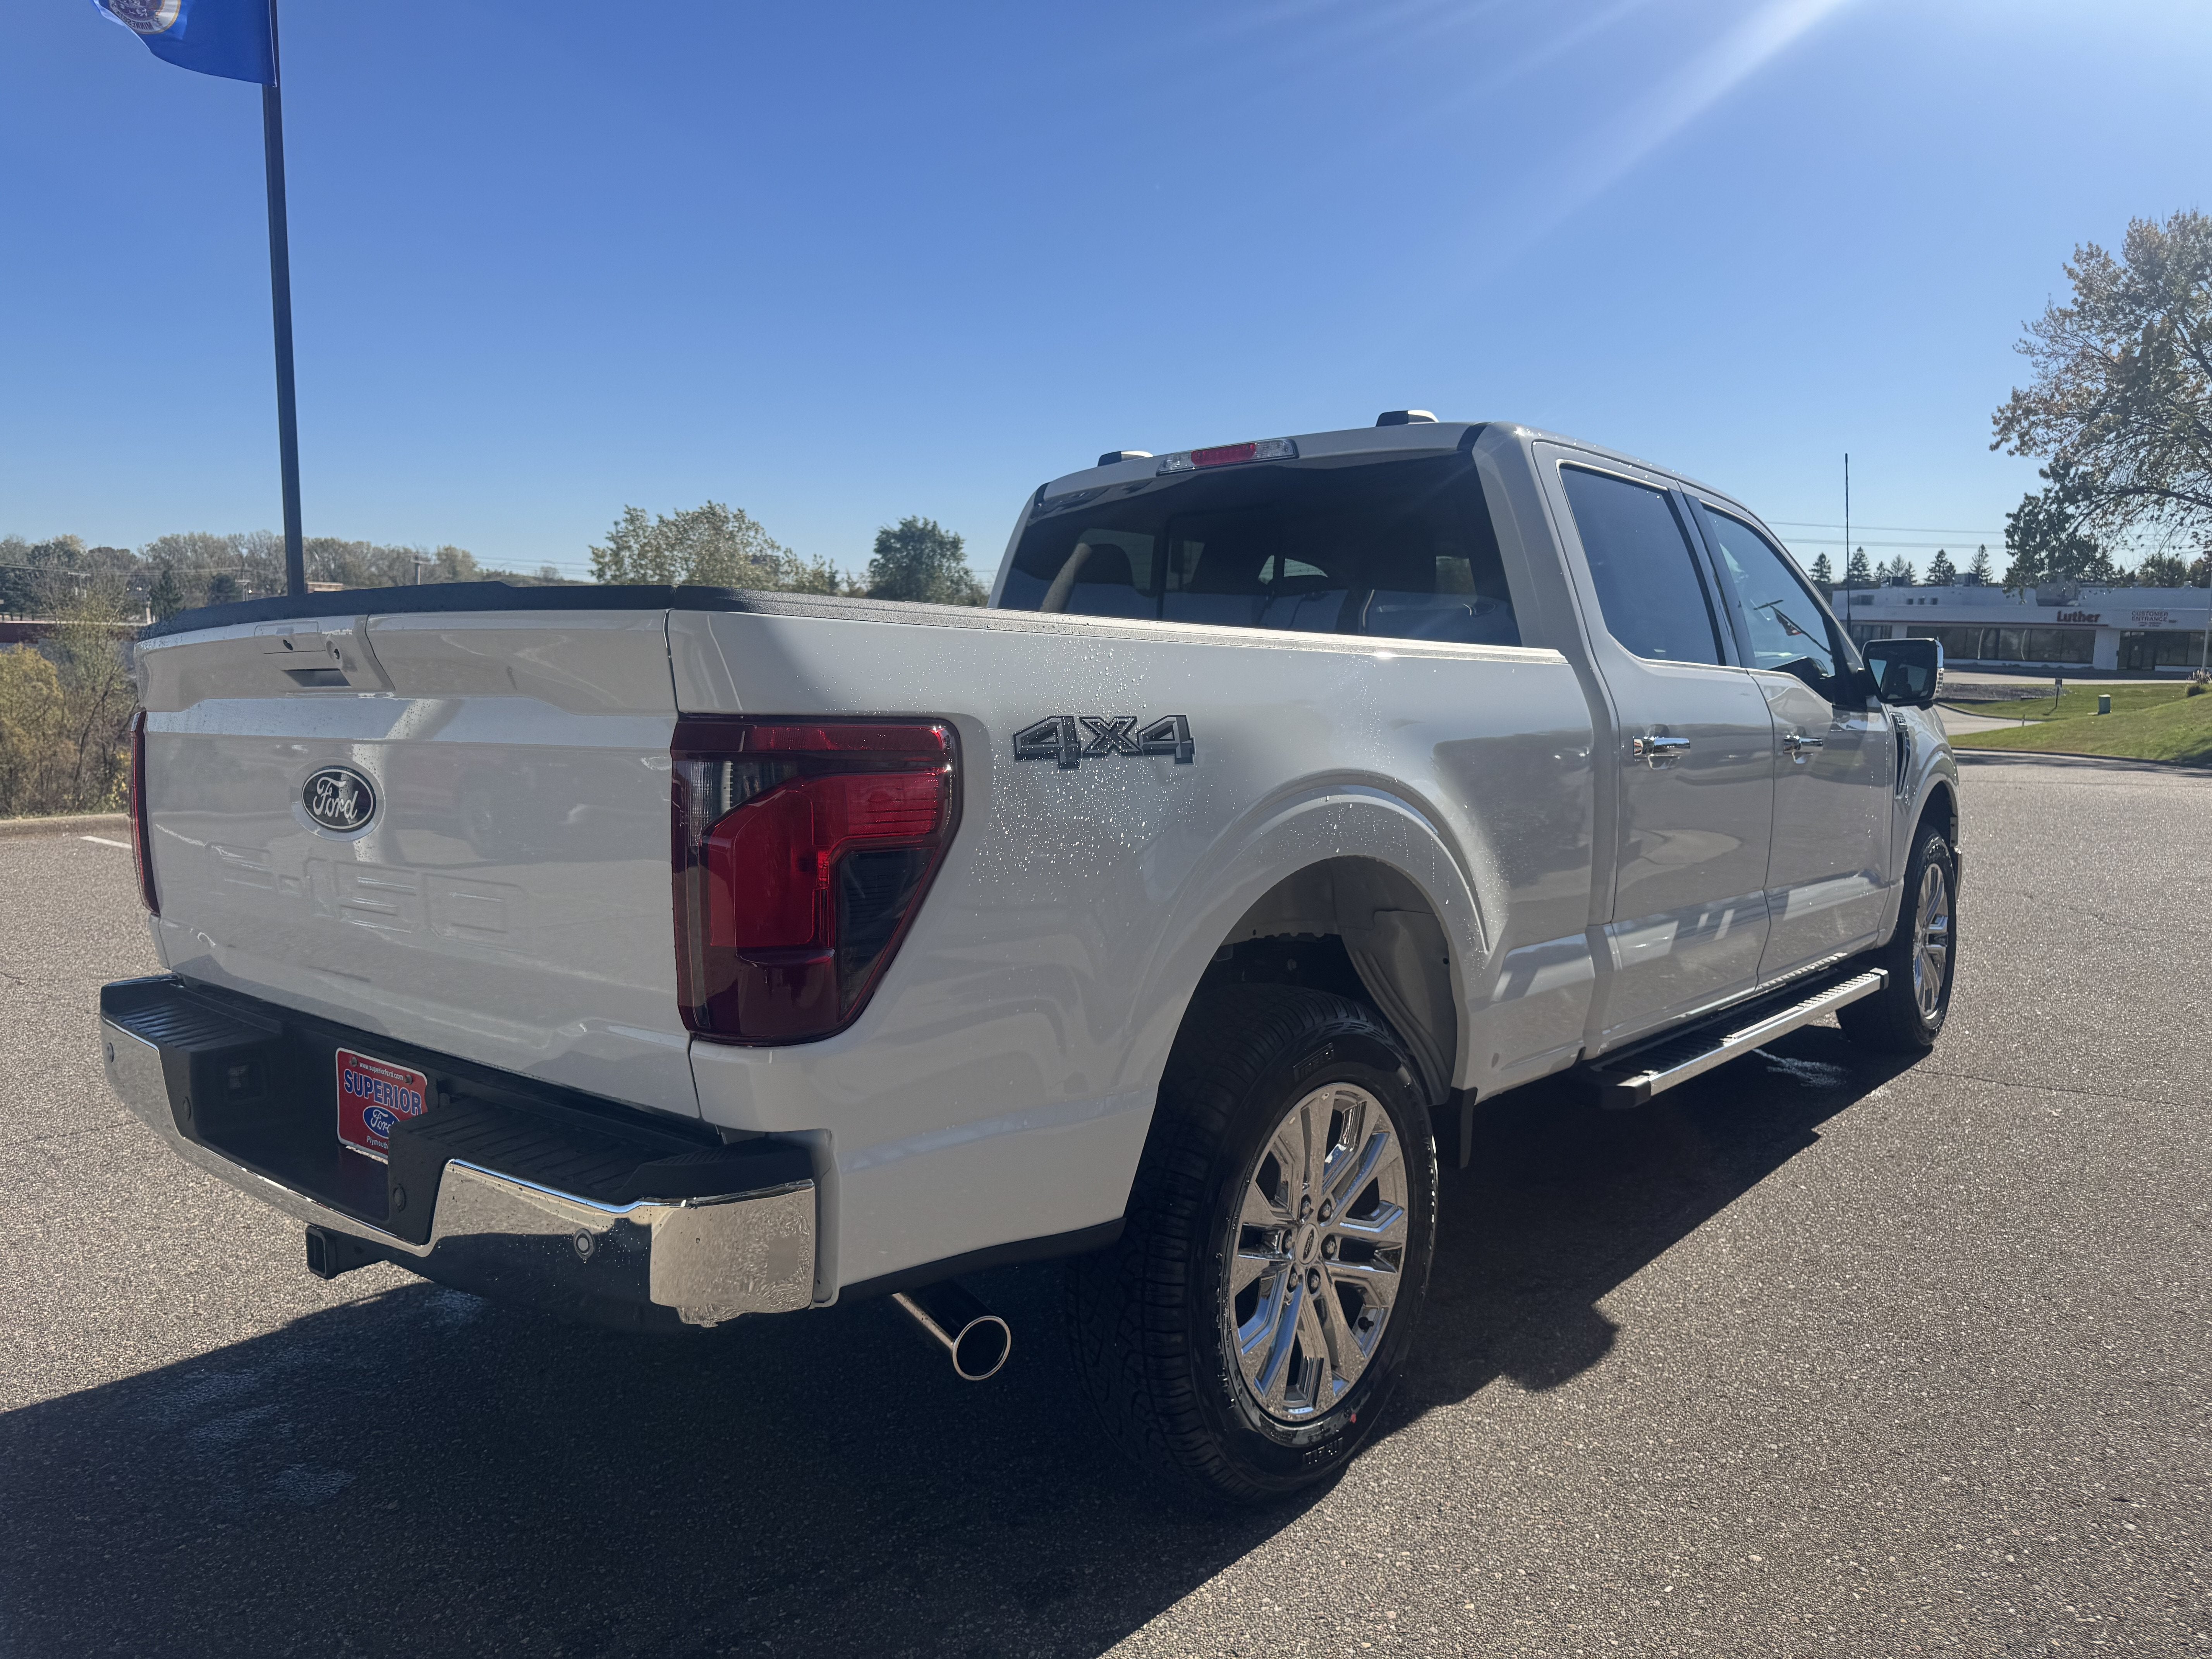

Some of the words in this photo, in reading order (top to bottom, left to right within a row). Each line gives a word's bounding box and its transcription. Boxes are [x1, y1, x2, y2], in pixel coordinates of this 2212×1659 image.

[2057, 610, 2100, 622] Luther
[313, 776, 359, 819] Ford
[344, 1069, 422, 1116] SUPERIOR
[367, 1135, 388, 1150] Plymouth
